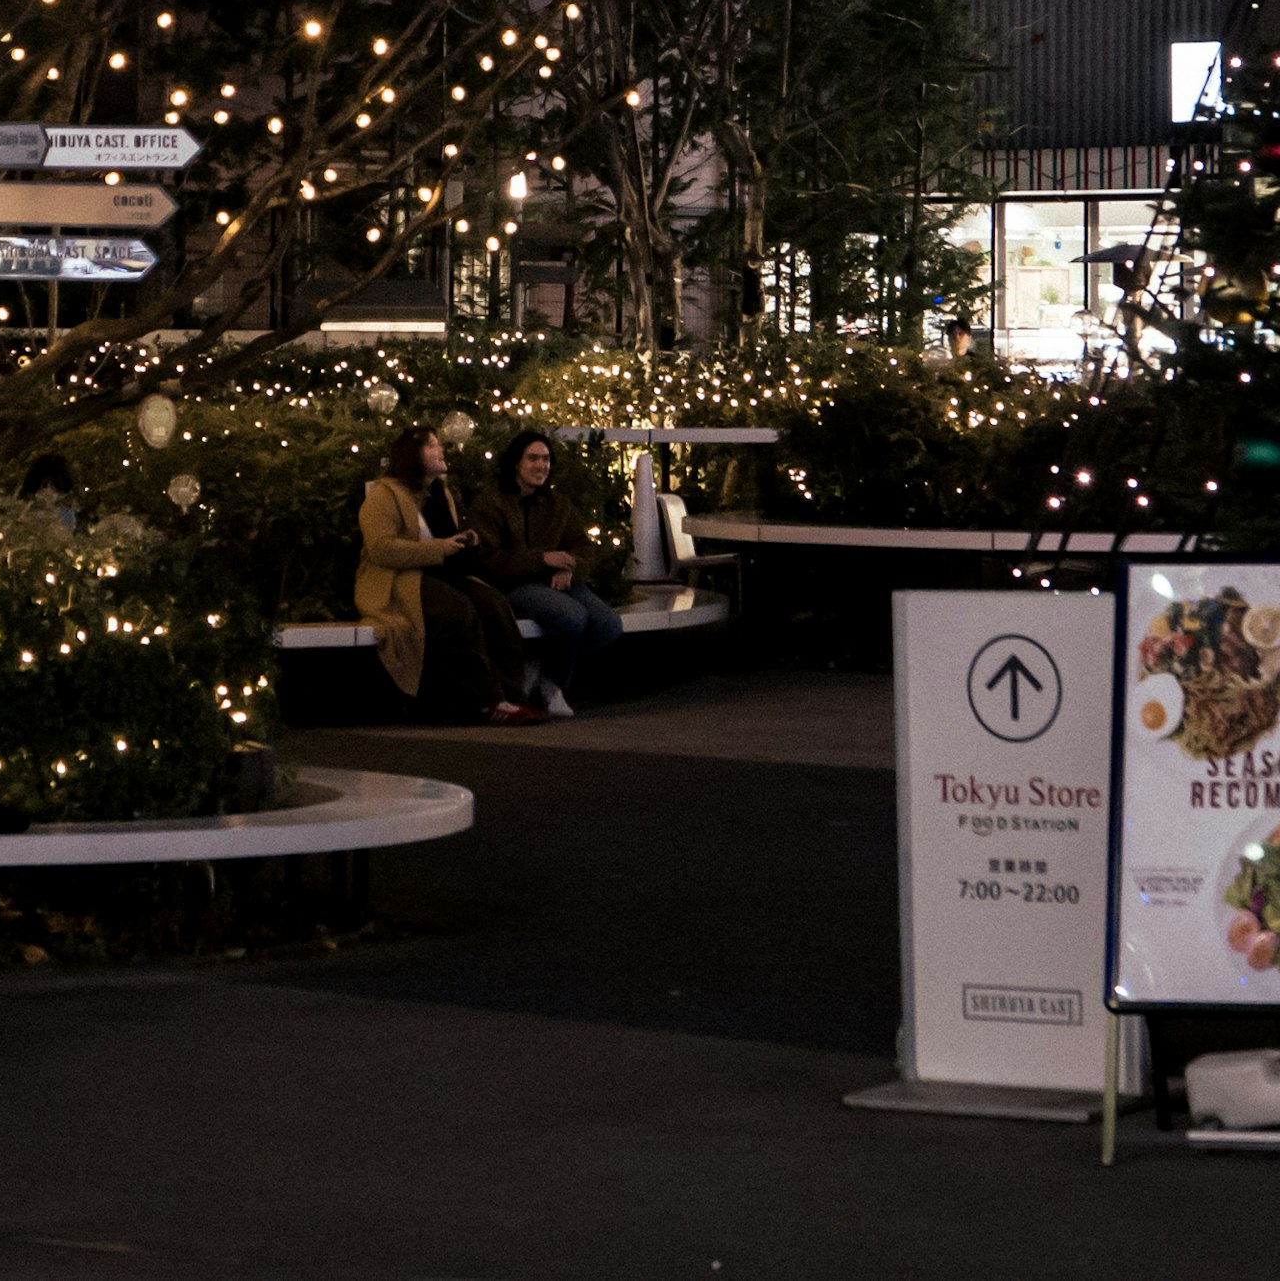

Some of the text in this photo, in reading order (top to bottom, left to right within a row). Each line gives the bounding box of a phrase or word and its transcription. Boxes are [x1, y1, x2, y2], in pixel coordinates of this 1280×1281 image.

[134, 134, 178, 149] OFFICE
[94, 245, 134, 259] SPACE
[934, 773, 1102, 810] Tokyu Store
